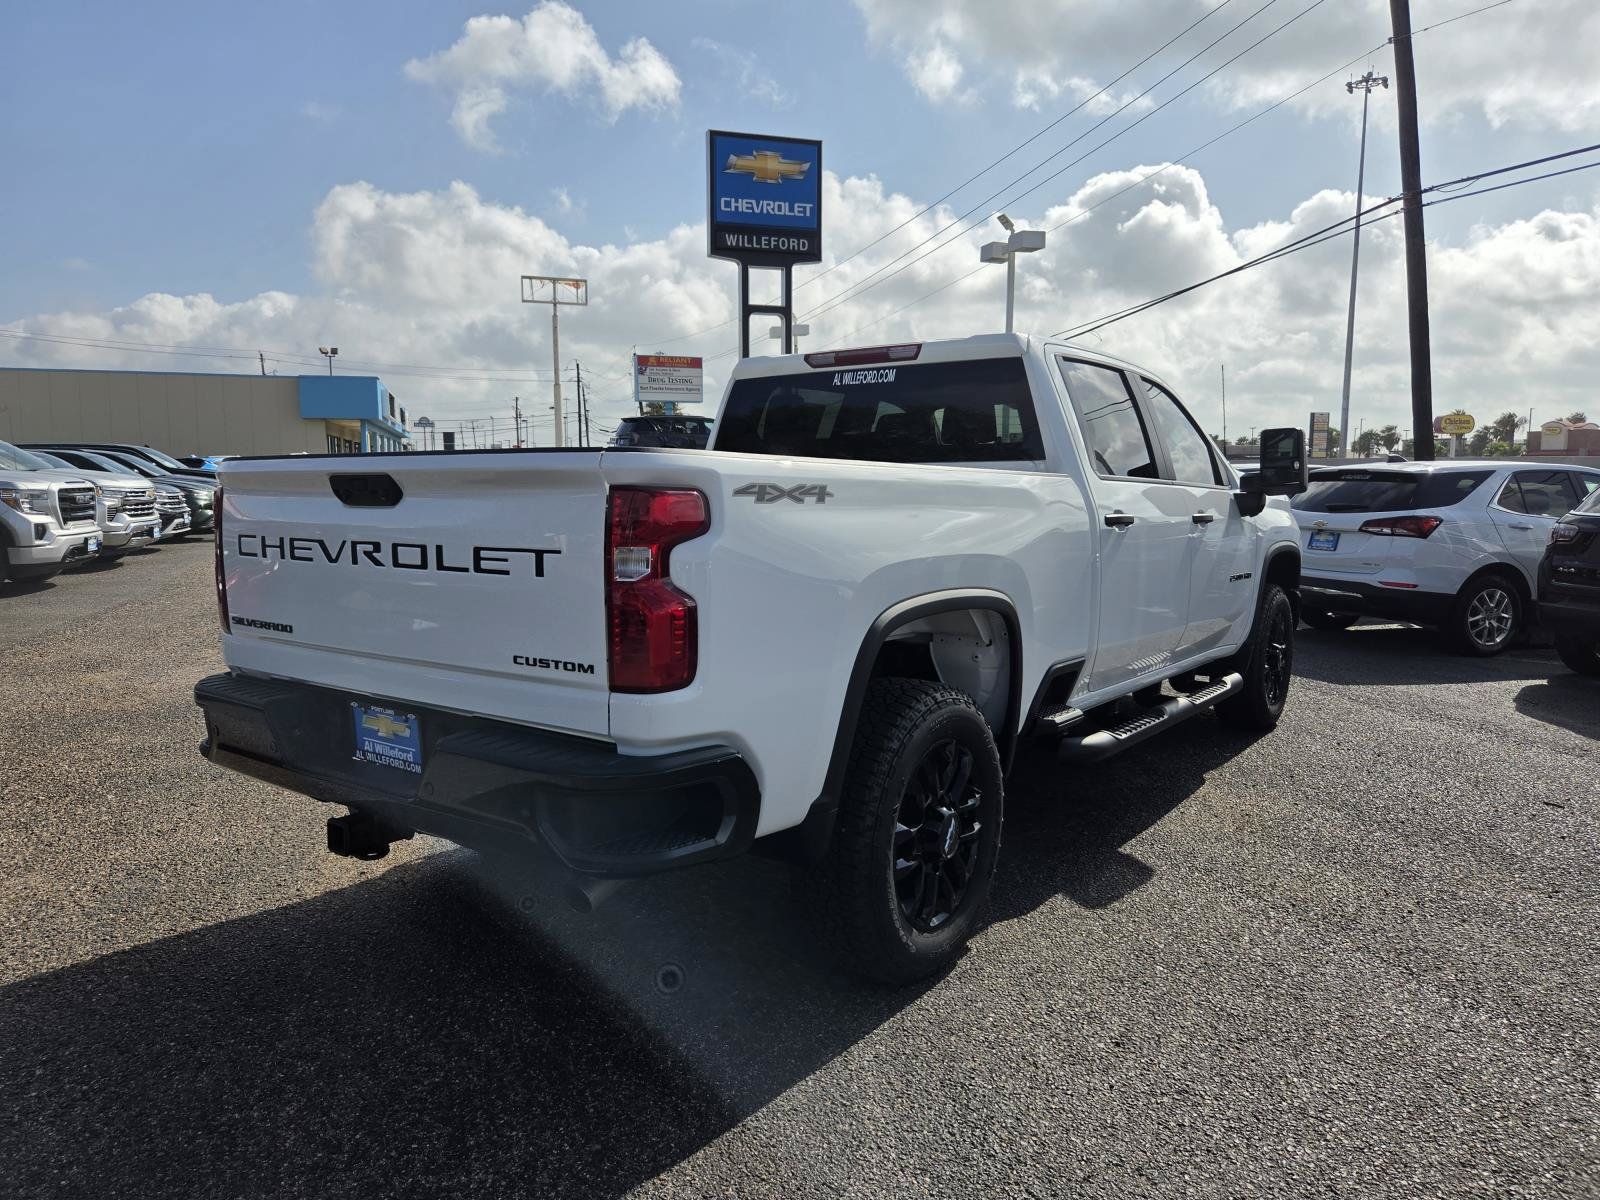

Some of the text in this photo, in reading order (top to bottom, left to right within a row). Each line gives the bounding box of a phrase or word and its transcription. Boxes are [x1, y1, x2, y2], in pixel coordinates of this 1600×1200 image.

[720, 197, 813, 217] CHEVROLET
[725, 233, 809, 251] WILLEFORD
[832, 368, 896, 386] AL WILLEFORD.COM
[237, 533, 562, 578] CHEVROLET
[231, 616, 294, 634] SILVERADO
[512, 654, 595, 675] CUSTOM
[364, 740, 414, 762] Al Willeford
[356, 749, 422, 774] AL WILLEFORD.COM
